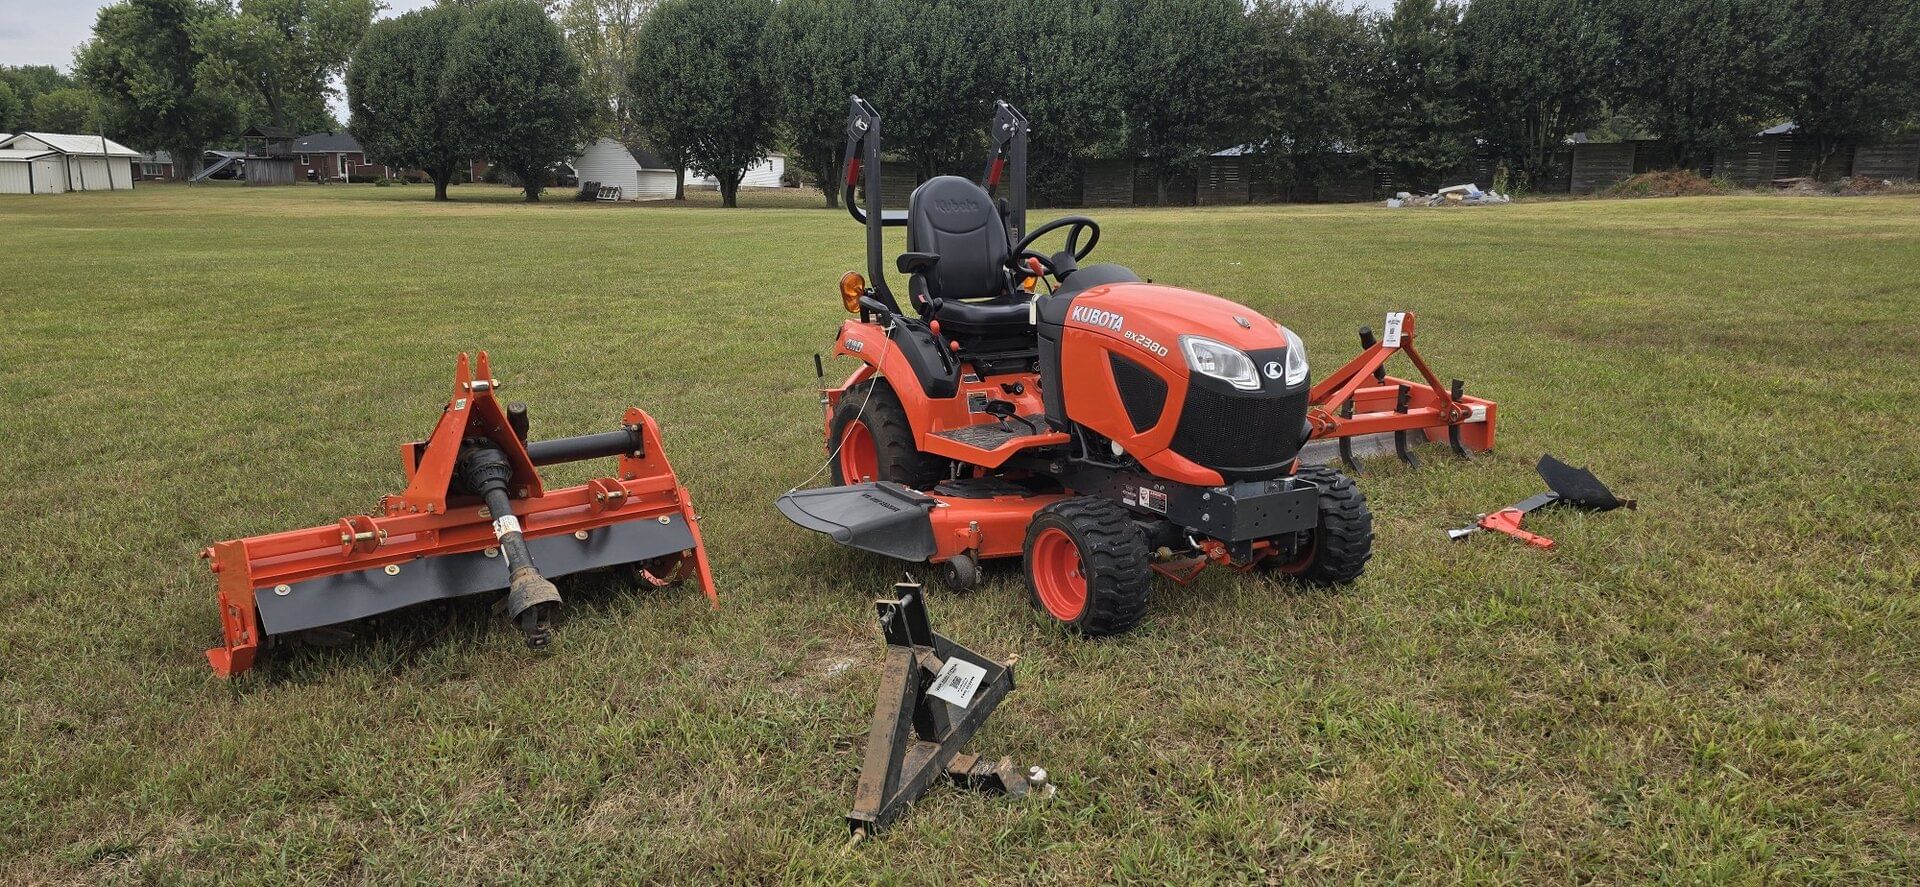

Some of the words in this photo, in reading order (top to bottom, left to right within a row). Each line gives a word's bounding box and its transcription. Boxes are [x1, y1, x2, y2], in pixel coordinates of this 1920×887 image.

[934, 199, 980, 213] Kubota
[1072, 305, 1124, 332] KUBOTA
[1124, 330, 1168, 357] BX2380
